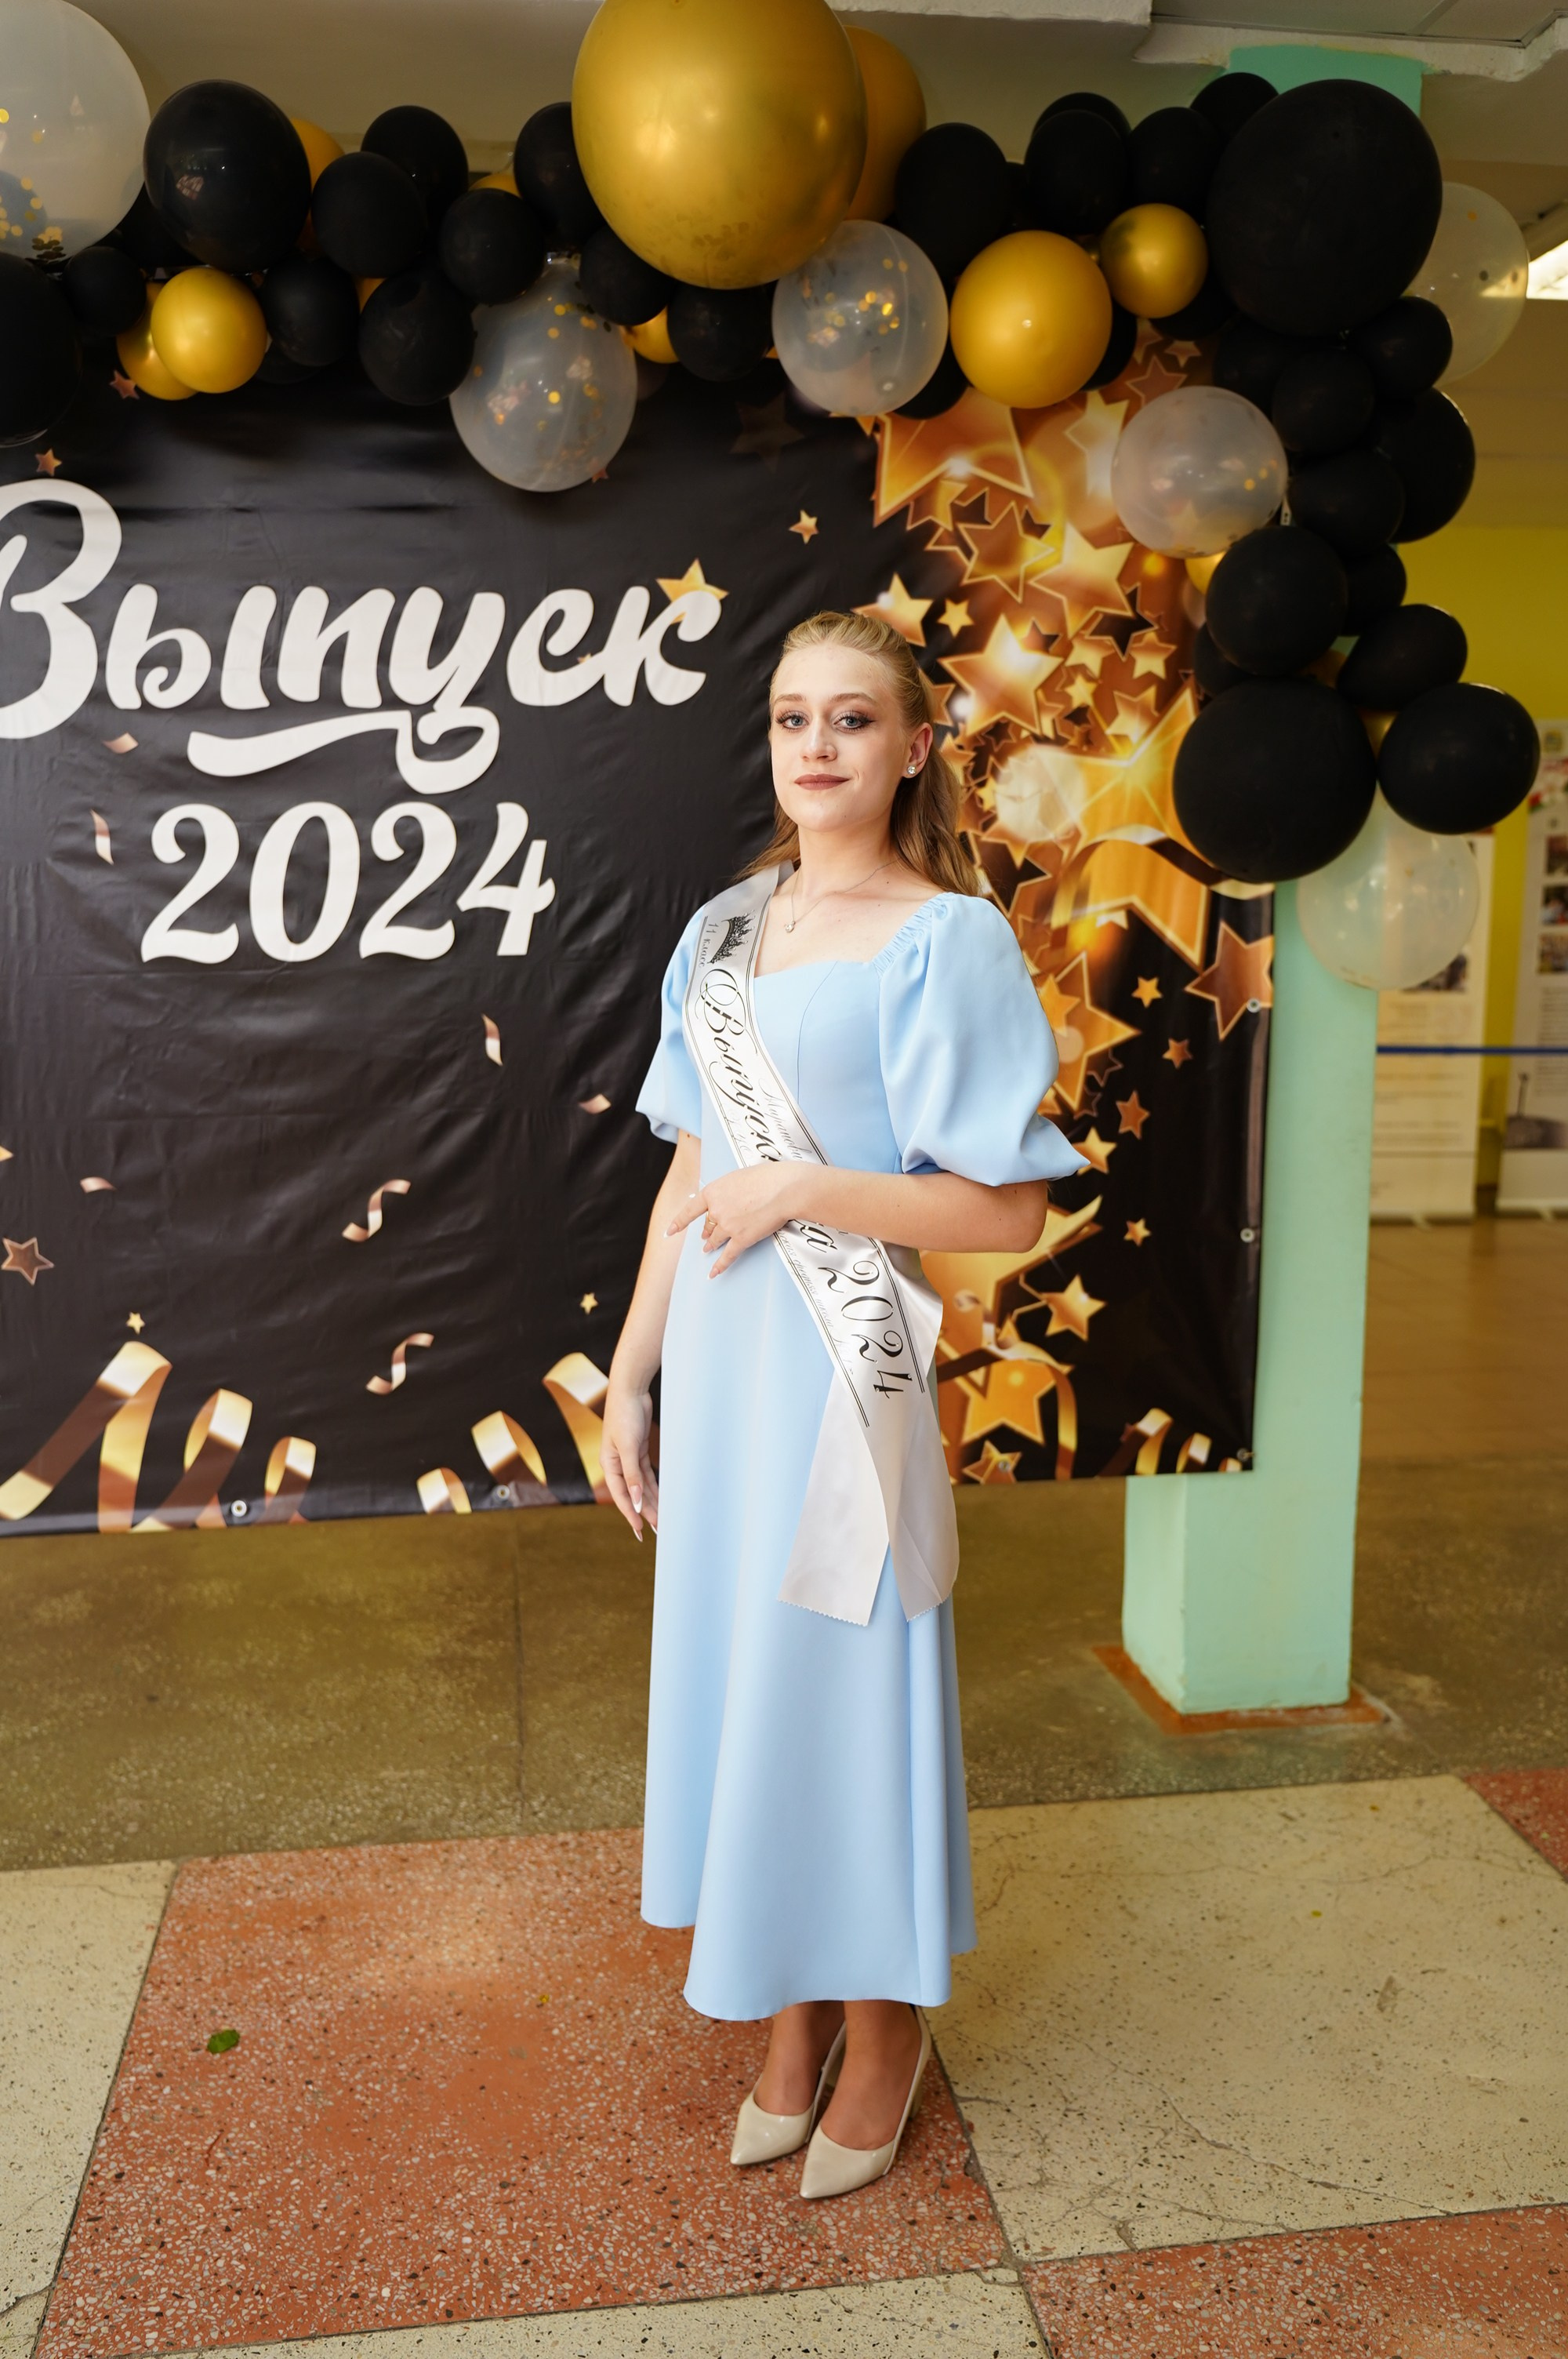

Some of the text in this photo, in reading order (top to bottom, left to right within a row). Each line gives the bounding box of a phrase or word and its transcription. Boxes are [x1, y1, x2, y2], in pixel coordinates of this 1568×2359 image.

[0, 478, 723, 794] Выпуск
[141, 801, 556, 965] 2024
[698, 922, 719, 968] 11 класс
[817, 1259, 913, 1399] 2024
